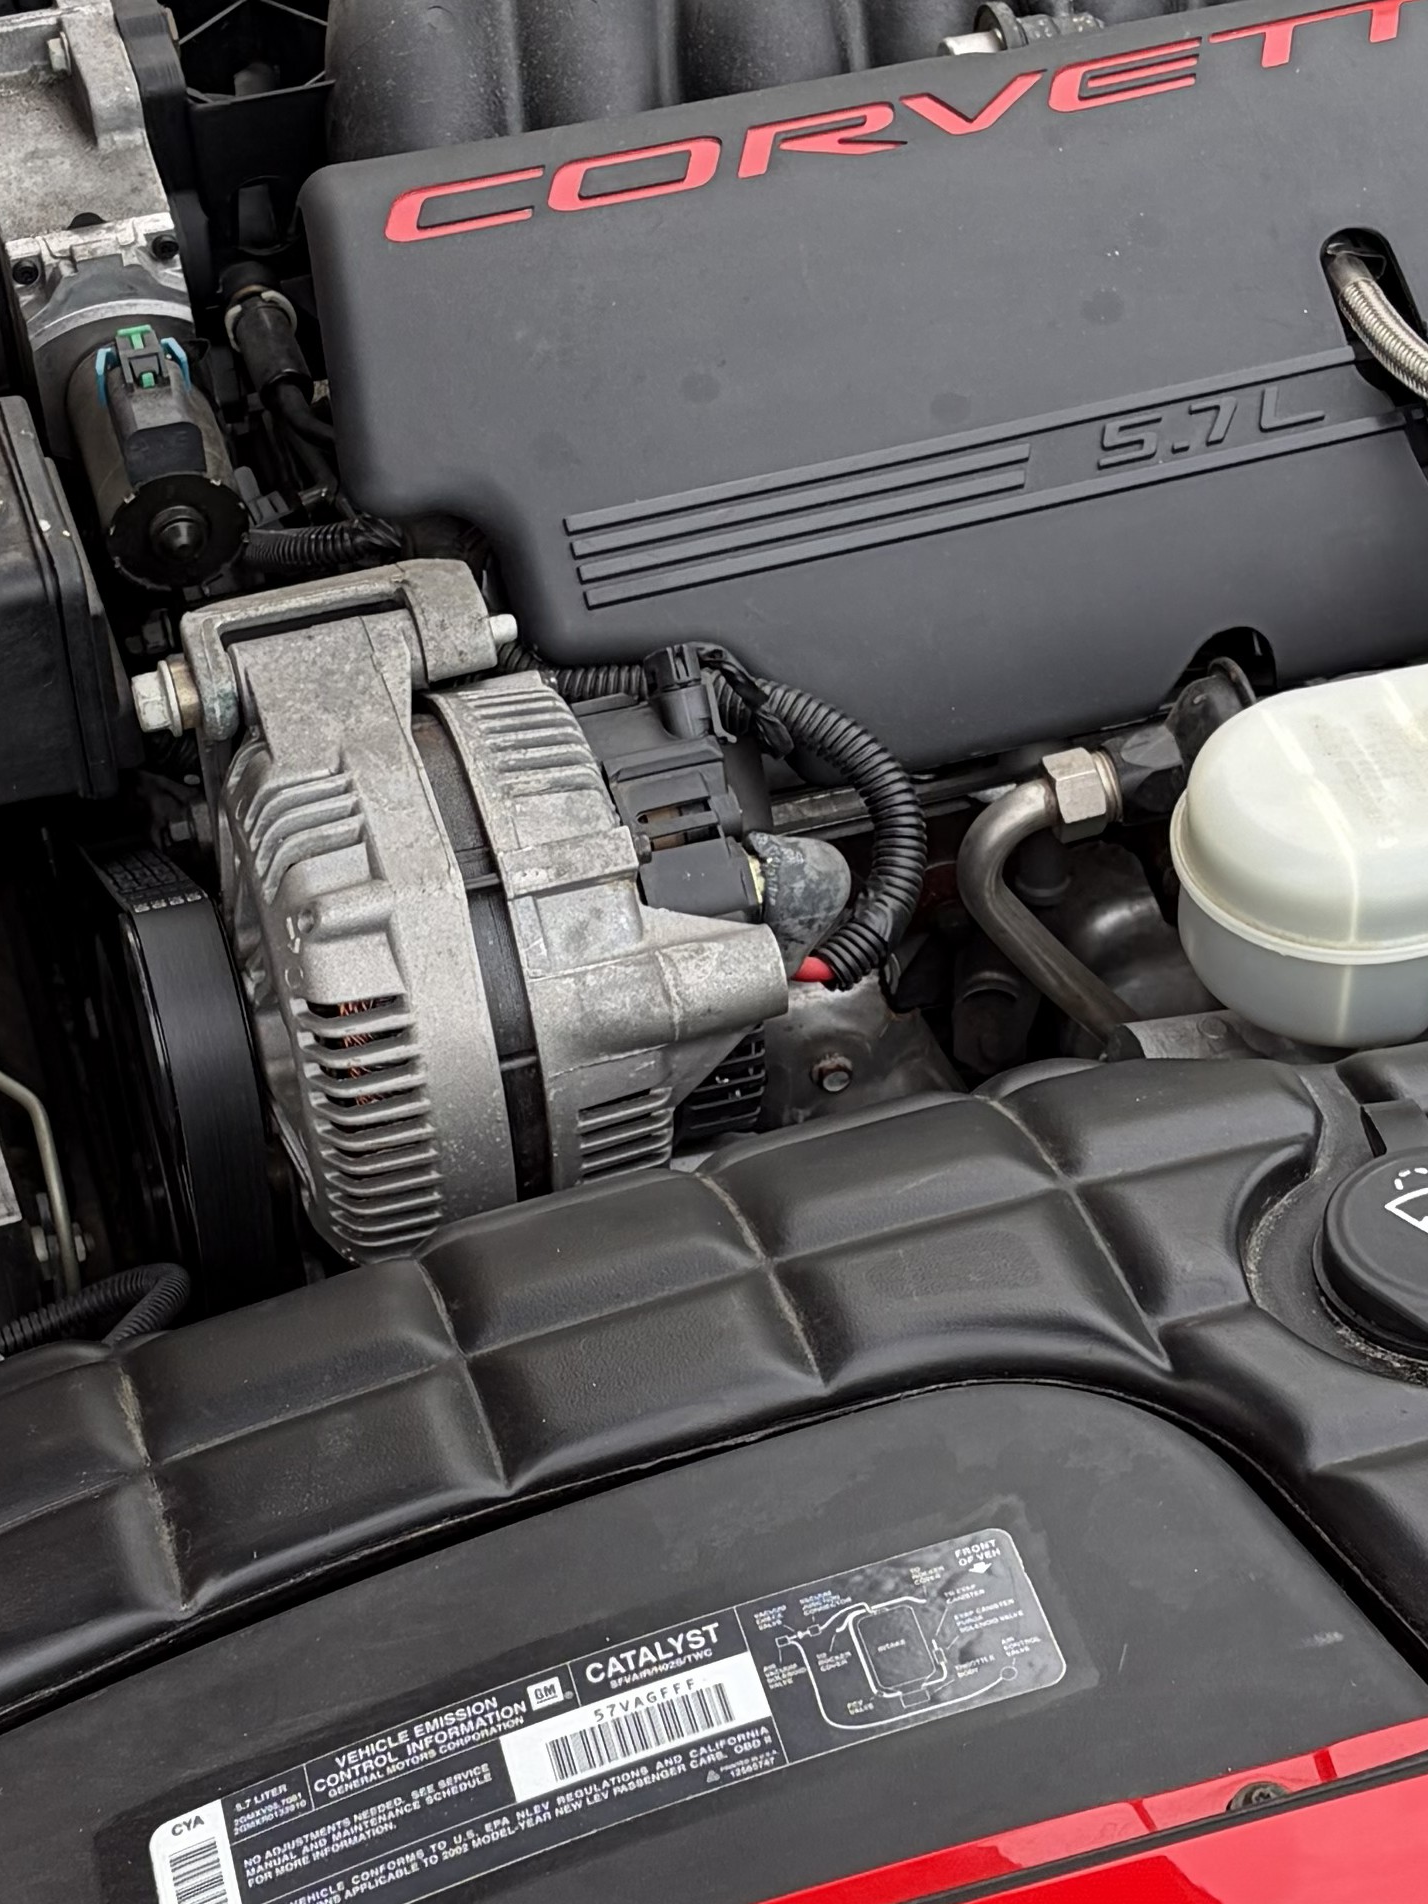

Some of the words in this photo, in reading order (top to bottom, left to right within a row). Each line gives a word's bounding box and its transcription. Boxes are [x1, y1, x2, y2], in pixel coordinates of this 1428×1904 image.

[1097, 388, 1326, 470] 5.7L
[585, 1622, 720, 1684] CATALYST
[313, 1752, 399, 1793] CONTROL
[406, 1700, 527, 1756] INFORMATION
[328, 1767, 384, 1799] GENERAL
[386, 1749, 437, 1776] MOTORS
[439, 1716, 525, 1755] CORPORATION
[335, 1729, 410, 1769] VEHICLE
[414, 1696, 499, 1737] EMISSION
[171, 1814, 205, 1838] CYA
[243, 1852, 260, 1869] NO
[261, 1818, 351, 1864] ADJUSTMENTS
[353, 1796, 406, 1824] NEEDED.
[410, 1783, 435, 1801] SEE
[437, 1762, 490, 1789] SERVICE
[246, 1849, 298, 1880] MANUAL
[301, 1835, 333, 1858] AND
[335, 1799, 422, 1846] MAINTENANCE
[424, 1772, 493, 1806] SCHEDULE
[254, 1783, 288, 1805] LITER
[344, 1861, 421, 1901] APPLICABLE
[421, 1852, 440, 1868] TO
[471, 1811, 553, 1848] MODEL-YEAR
[555, 1798, 585, 1818] NEW
[613, 1764, 689, 1797] PASSENGER
[733, 1738, 763, 1755] OBD
[351, 1849, 425, 1885] CONFORMS
[429, 1838, 448, 1853] TO
[484, 1815, 511, 1833] EPA
[556, 1764, 650, 1807] REGULATIONS
[655, 1753, 684, 1770] AND
[688, 1725, 770, 1759] CALIFORNIA
[247, 1870, 272, 1888] FOR
[274, 1855, 311, 1880] MORE
